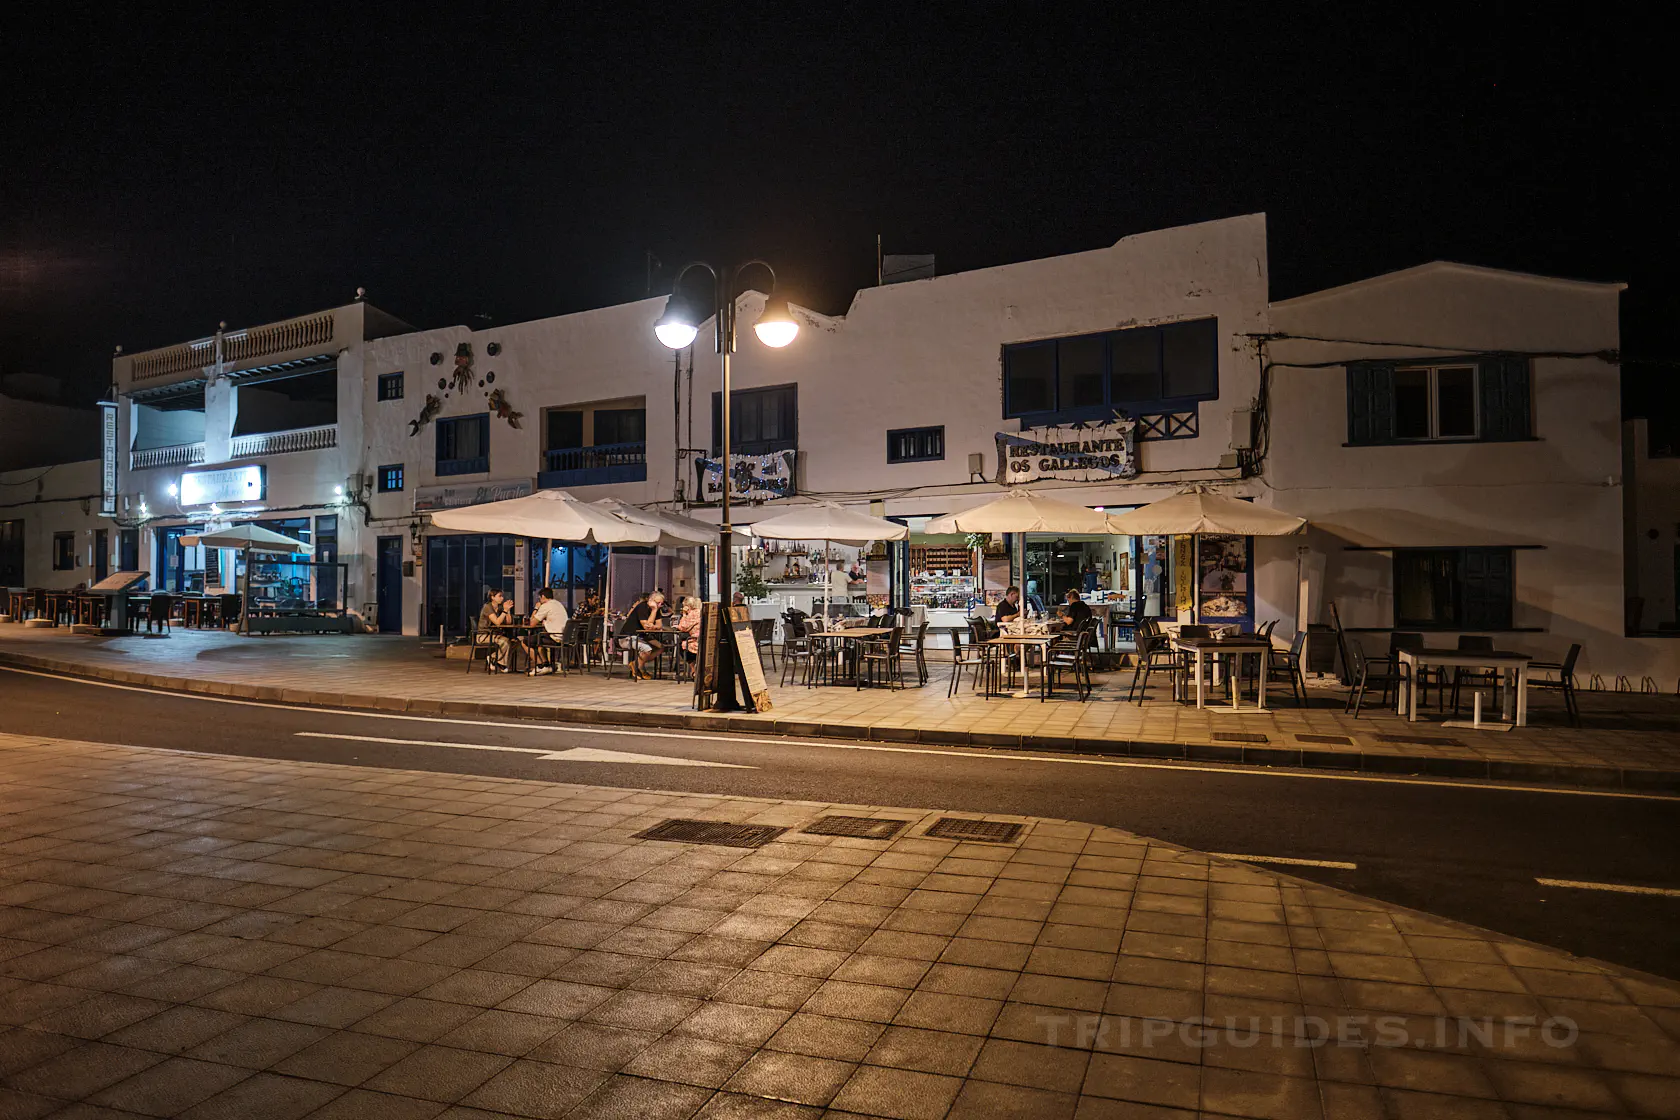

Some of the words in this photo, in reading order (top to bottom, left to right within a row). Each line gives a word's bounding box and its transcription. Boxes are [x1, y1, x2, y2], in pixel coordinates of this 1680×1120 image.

[1009, 438, 1125, 457] RESTAURANTE
[105, 413, 114, 504] RESTAURANTE
[1010, 459, 1031, 473] OS
[1039, 453, 1120, 472] GALLEGOS
